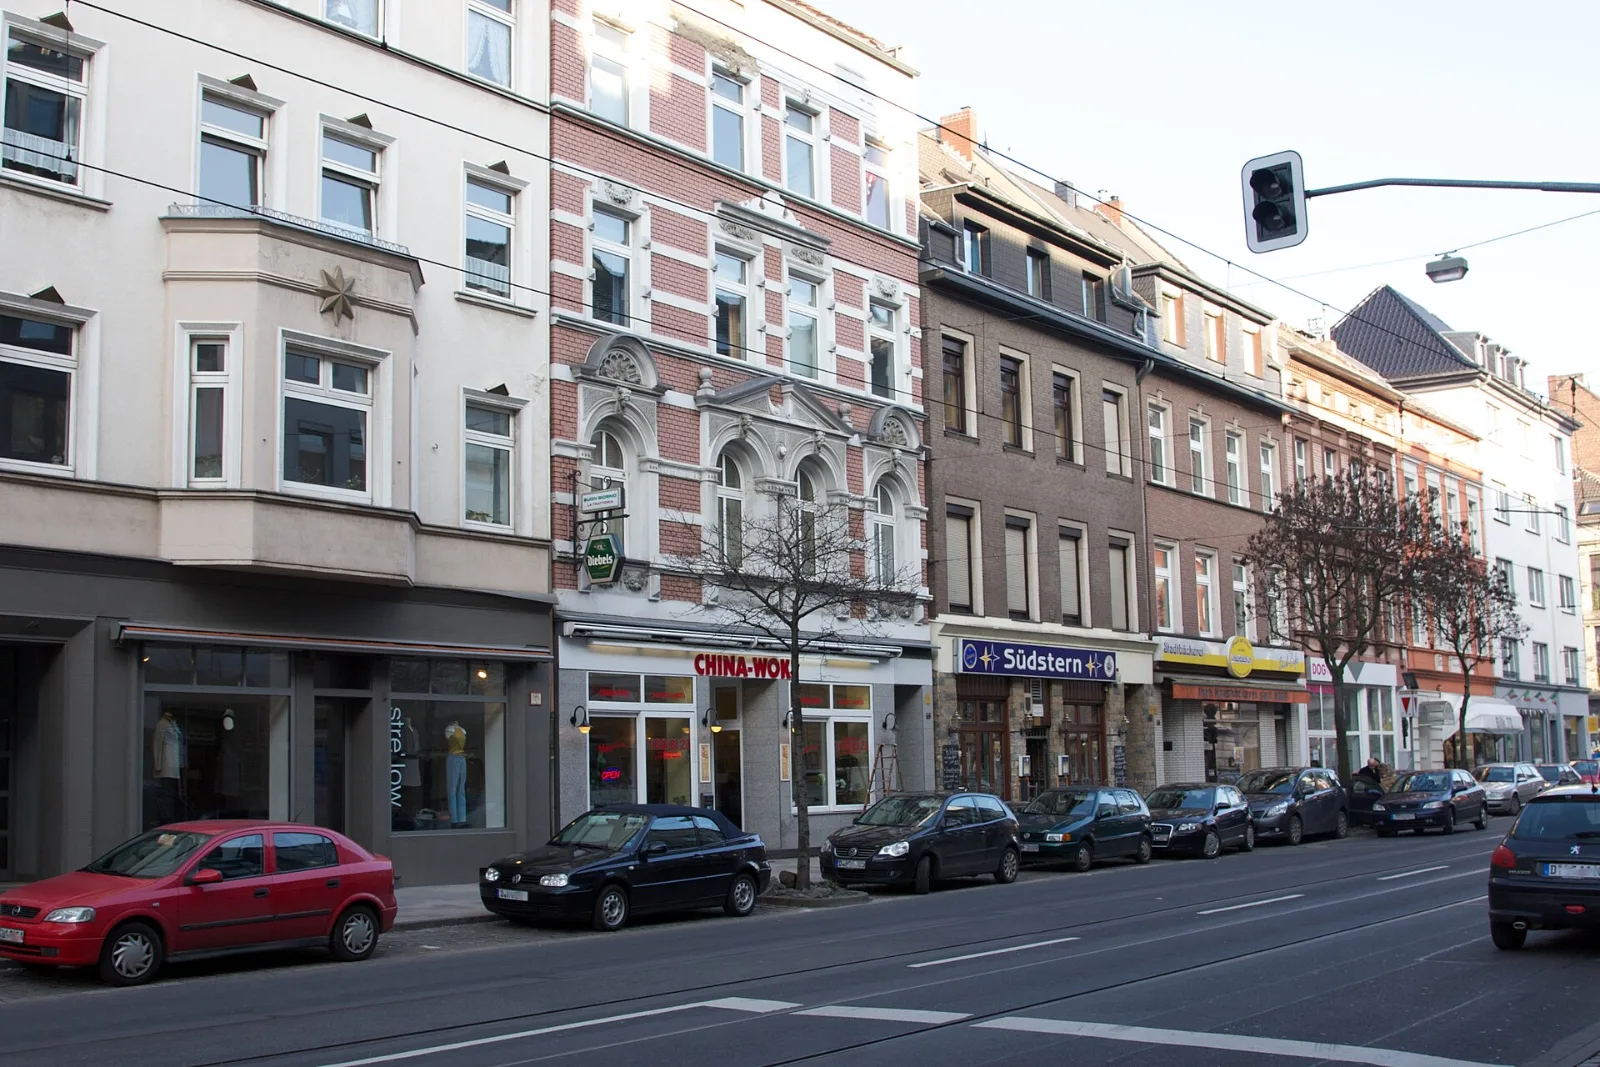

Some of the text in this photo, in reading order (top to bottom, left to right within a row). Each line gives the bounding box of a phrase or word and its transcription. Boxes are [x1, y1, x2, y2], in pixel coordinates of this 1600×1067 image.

[587, 554, 613, 566] Diebels
[694, 654, 792, 679] CHINA-WOK
[1004, 649, 1082, 673] Südstern
[1312, 663, 1327, 676] DOG
[601, 770, 621, 780] OPEN
